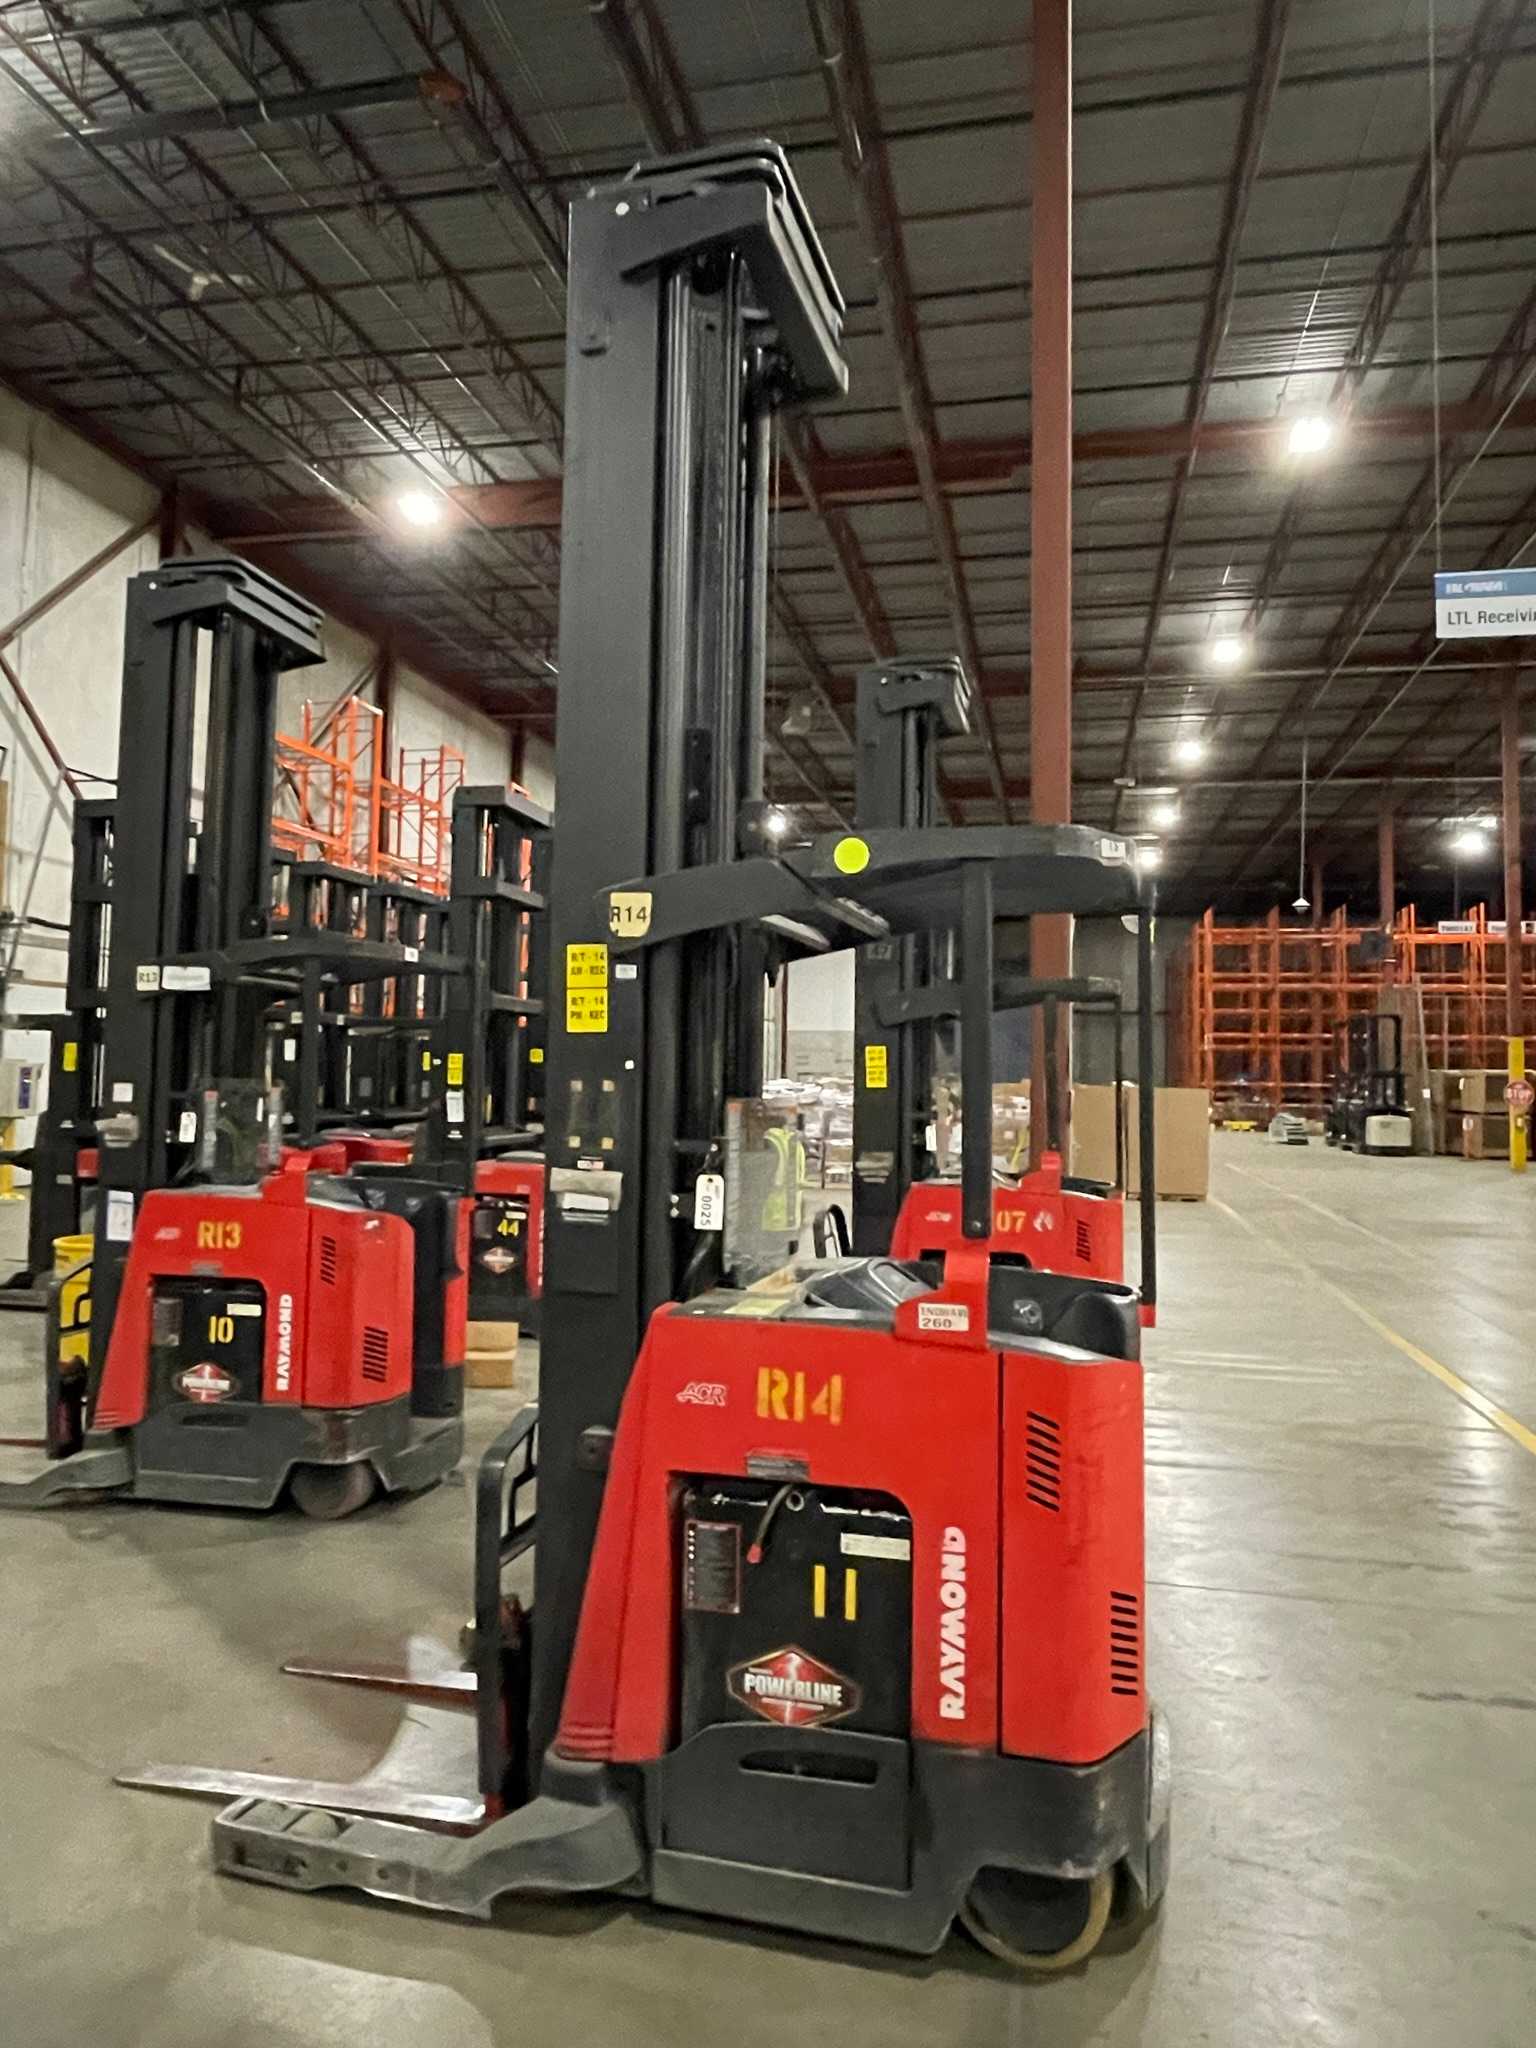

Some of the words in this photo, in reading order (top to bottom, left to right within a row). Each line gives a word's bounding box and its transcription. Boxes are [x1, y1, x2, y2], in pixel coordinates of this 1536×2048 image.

[1447, 611, 1473, 625] LTL
[610, 906, 647, 922] R14
[139, 972, 158, 983] R13
[198, 1221, 242, 1248] R13
[497, 1218, 519, 1236] 44
[208, 1315, 235, 1344] 10
[921, 1317, 953, 1329] 260
[276, 1294, 293, 1391] RAYMOND
[756, 1366, 843, 1425] R14
[814, 1564, 857, 1621] 11
[940, 1526, 966, 1720] RAYMOND
[744, 1673, 843, 1706] POWERLINE
